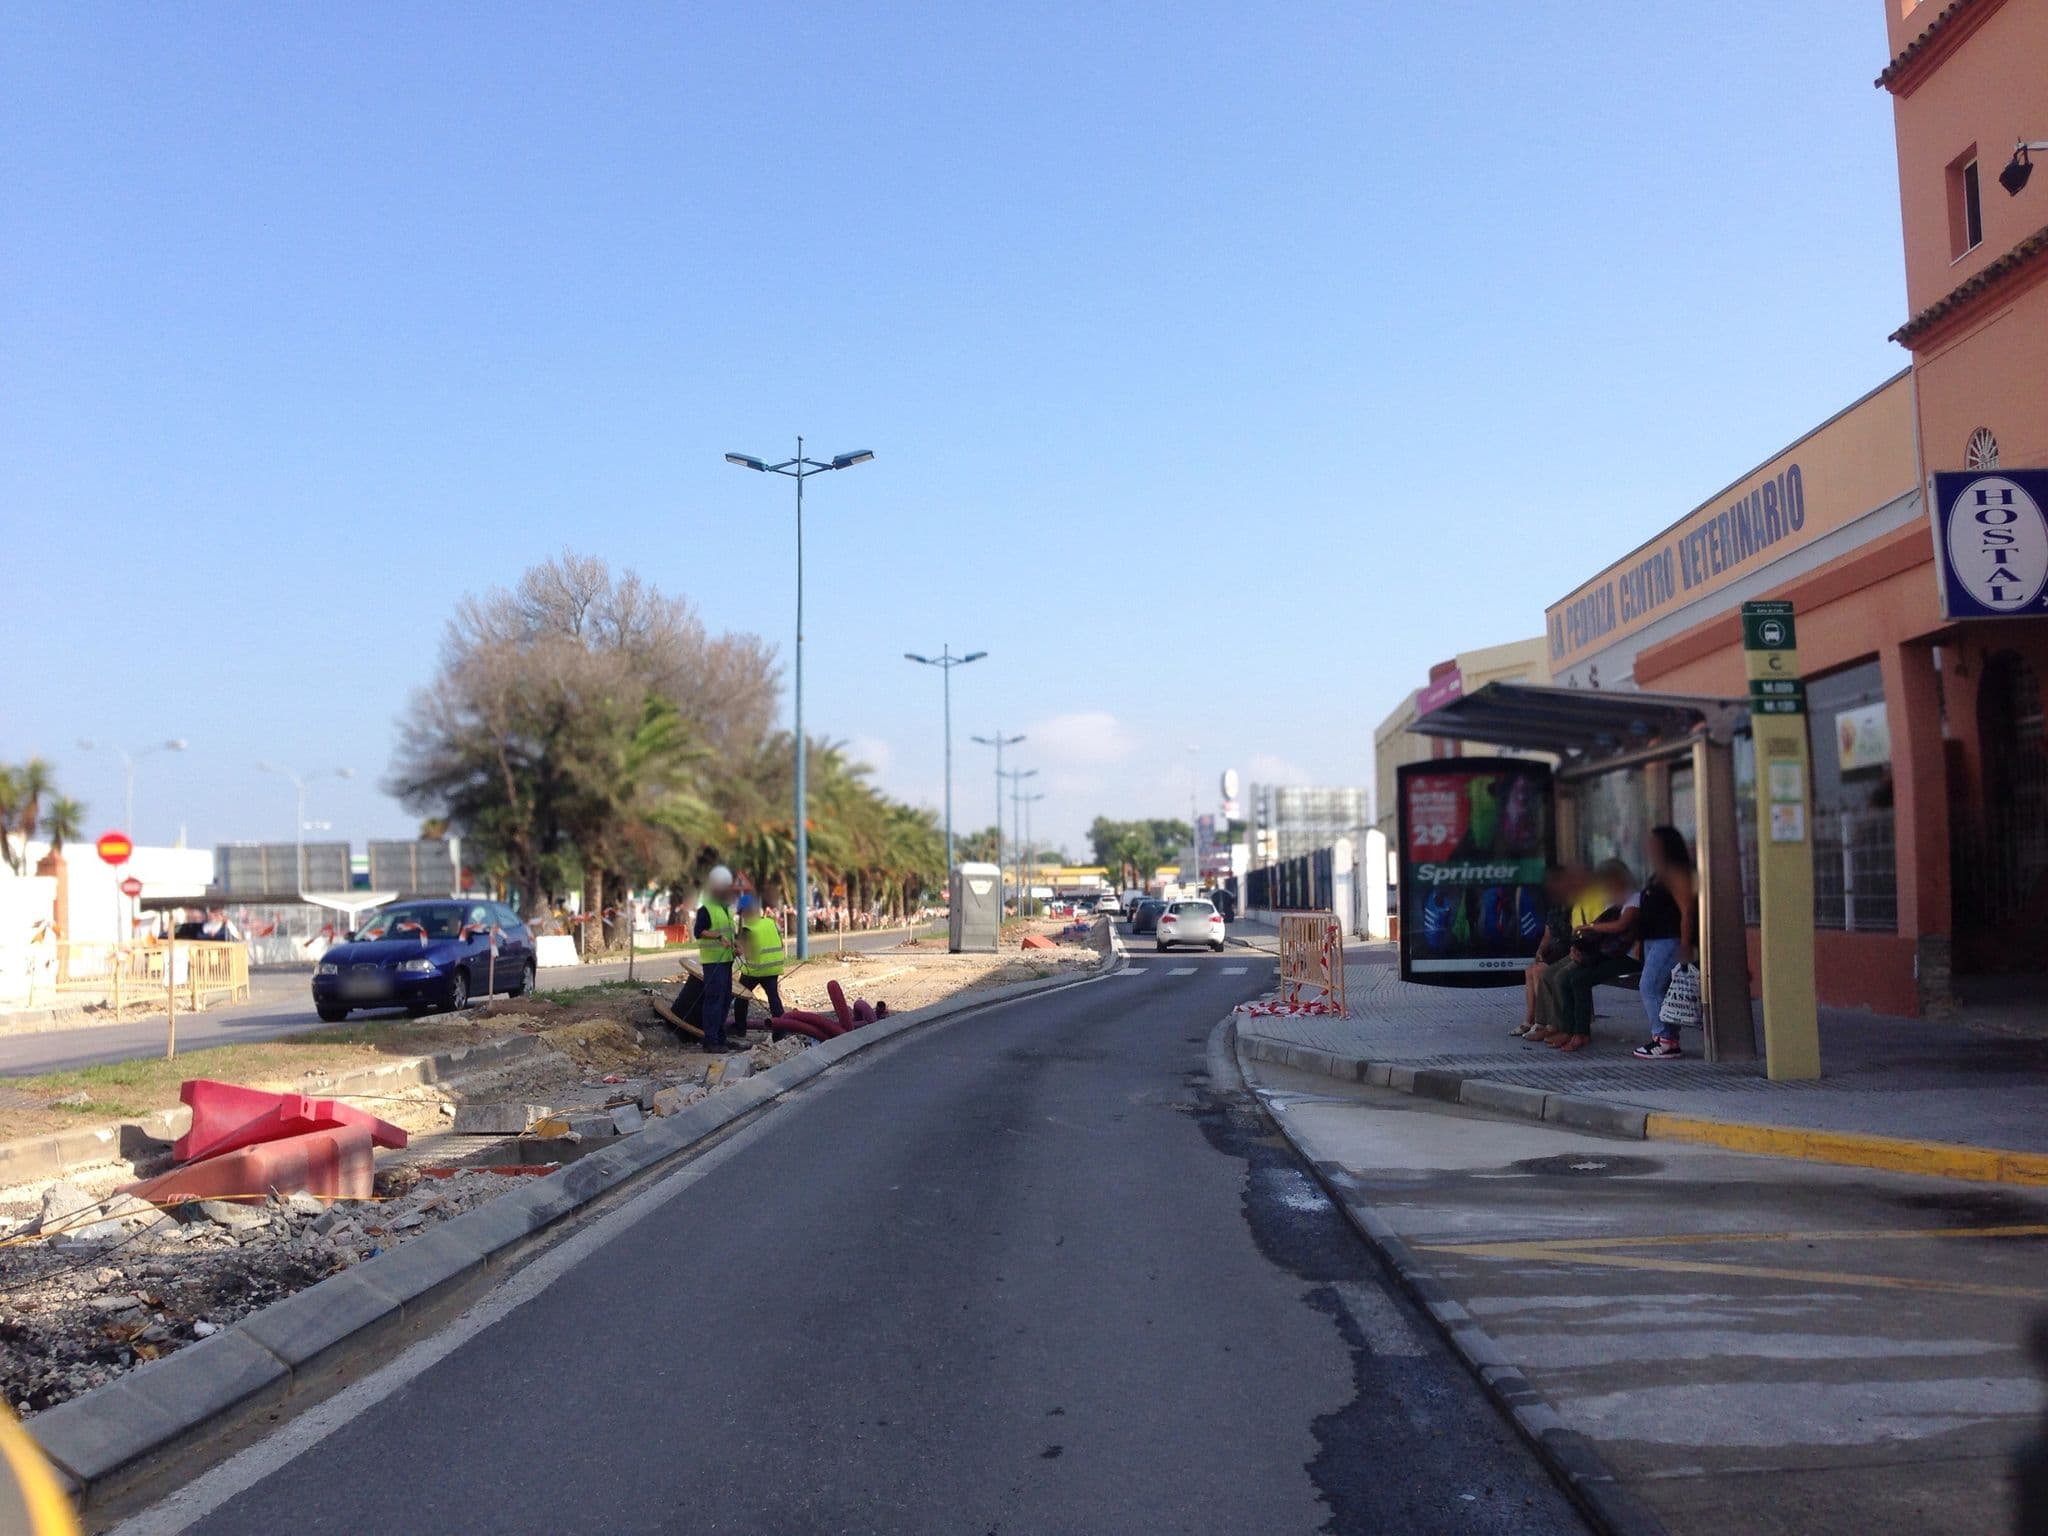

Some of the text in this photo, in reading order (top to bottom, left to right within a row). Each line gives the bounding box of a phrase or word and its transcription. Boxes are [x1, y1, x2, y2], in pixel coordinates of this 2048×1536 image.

[1551, 463, 1805, 660] LA PEDRIZA CENTRO VETERINARIO
[1973, 488, 2024, 601] HOSTAL
[1769, 656, 1782, 670] C
[1417, 861, 1520, 885] Sprinter
